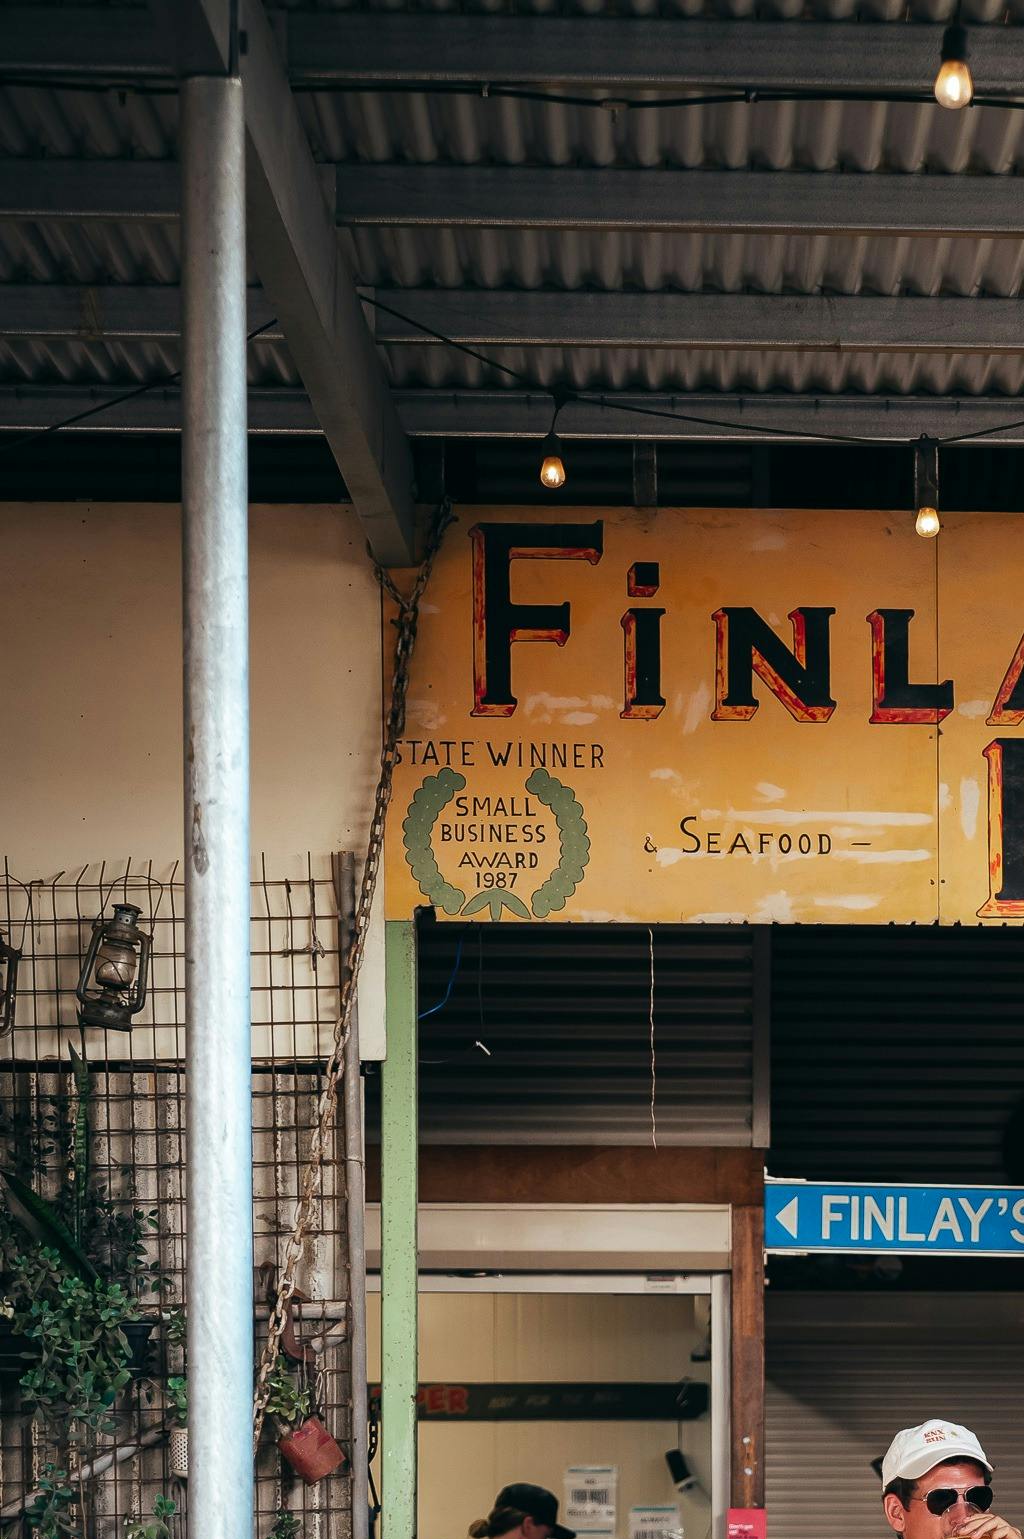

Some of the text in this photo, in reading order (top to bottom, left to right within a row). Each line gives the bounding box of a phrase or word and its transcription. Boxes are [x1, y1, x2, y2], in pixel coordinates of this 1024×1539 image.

[486, 739, 605, 768] WINNER
[456, 796, 537, 817] SMALL
[440, 823, 546, 843] BUSINESS
[644, 816, 832, 855] & SEAFOOD
[458, 852, 538, 868] AWARD
[476, 872, 518, 889] 1987
